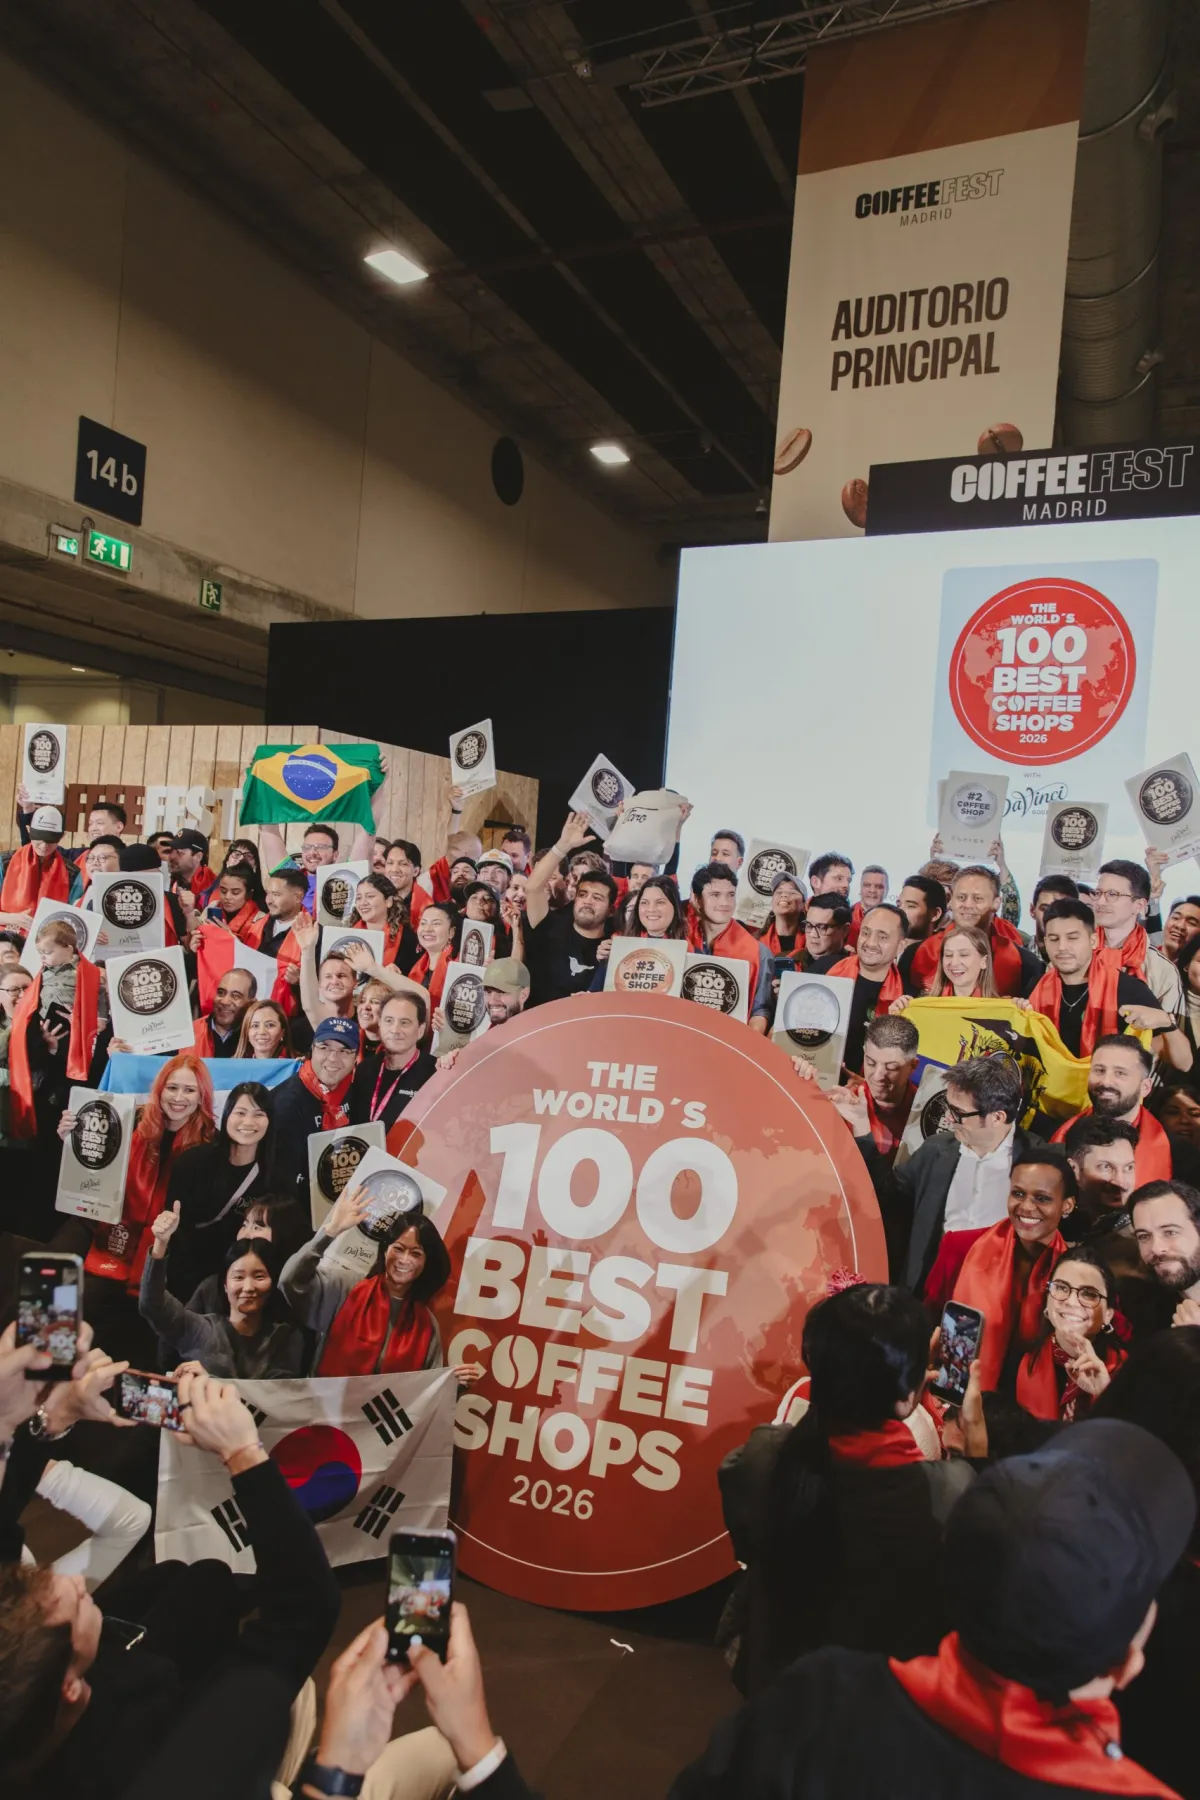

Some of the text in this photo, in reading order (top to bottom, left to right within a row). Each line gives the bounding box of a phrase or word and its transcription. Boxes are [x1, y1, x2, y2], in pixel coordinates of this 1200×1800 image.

[899, 208, 953, 227] MADRID
[831, 277, 1009, 341] AUDITORIO
[830, 331, 1000, 391] PRINCIPAL
[1022, 499, 1107, 520] MADRID
[1030, 603, 1057, 613] THE
[996, 625, 1088, 664] 100
[992, 666, 1087, 693] BEST
[991, 695, 1083, 713] COFFEE
[995, 714, 1074, 732] SHOPS
[1019, 733, 1048, 743] 2026
[967, 792, 983, 801] #2
[1148, 780, 1175, 800] 100
[957, 801, 990, 810] COFFEE
[1152, 790, 1178, 807] BEST
[960, 808, 984, 816] SHOP
[1064, 817, 1087, 828] 100
[762, 858, 786, 872] 100
[115, 892, 143, 903] 100
[115, 902, 143, 911] BEST
[467, 942, 479, 955] 100
[636, 961, 655, 971] #3
[131, 971, 161, 987] 100
[623, 972, 665, 982] COFFEE
[696, 974, 726, 990] 100
[132, 982, 163, 996] BEST
[628, 981, 658, 990] SHOP
[693, 987, 725, 998] BEST
[134, 991, 163, 1002] COFFEE
[135, 997, 162, 1008] SHOPS
[457, 987, 477, 1003] 100
[455, 999, 476, 1012] BEST
[586, 1061, 658, 1091] THE
[84, 1115, 109, 1134] 100
[81, 1131, 108, 1145] BEST
[81, 1148, 103, 1159] SHOPS
[330, 1151, 360, 1169] 100
[489, 1122, 739, 1254] 100
[453, 1237, 729, 1354] BEST
[448, 1328, 713, 1426] COFFEE
[453, 1393, 684, 1492] SHOPS
[508, 1475, 595, 1520] 2026
